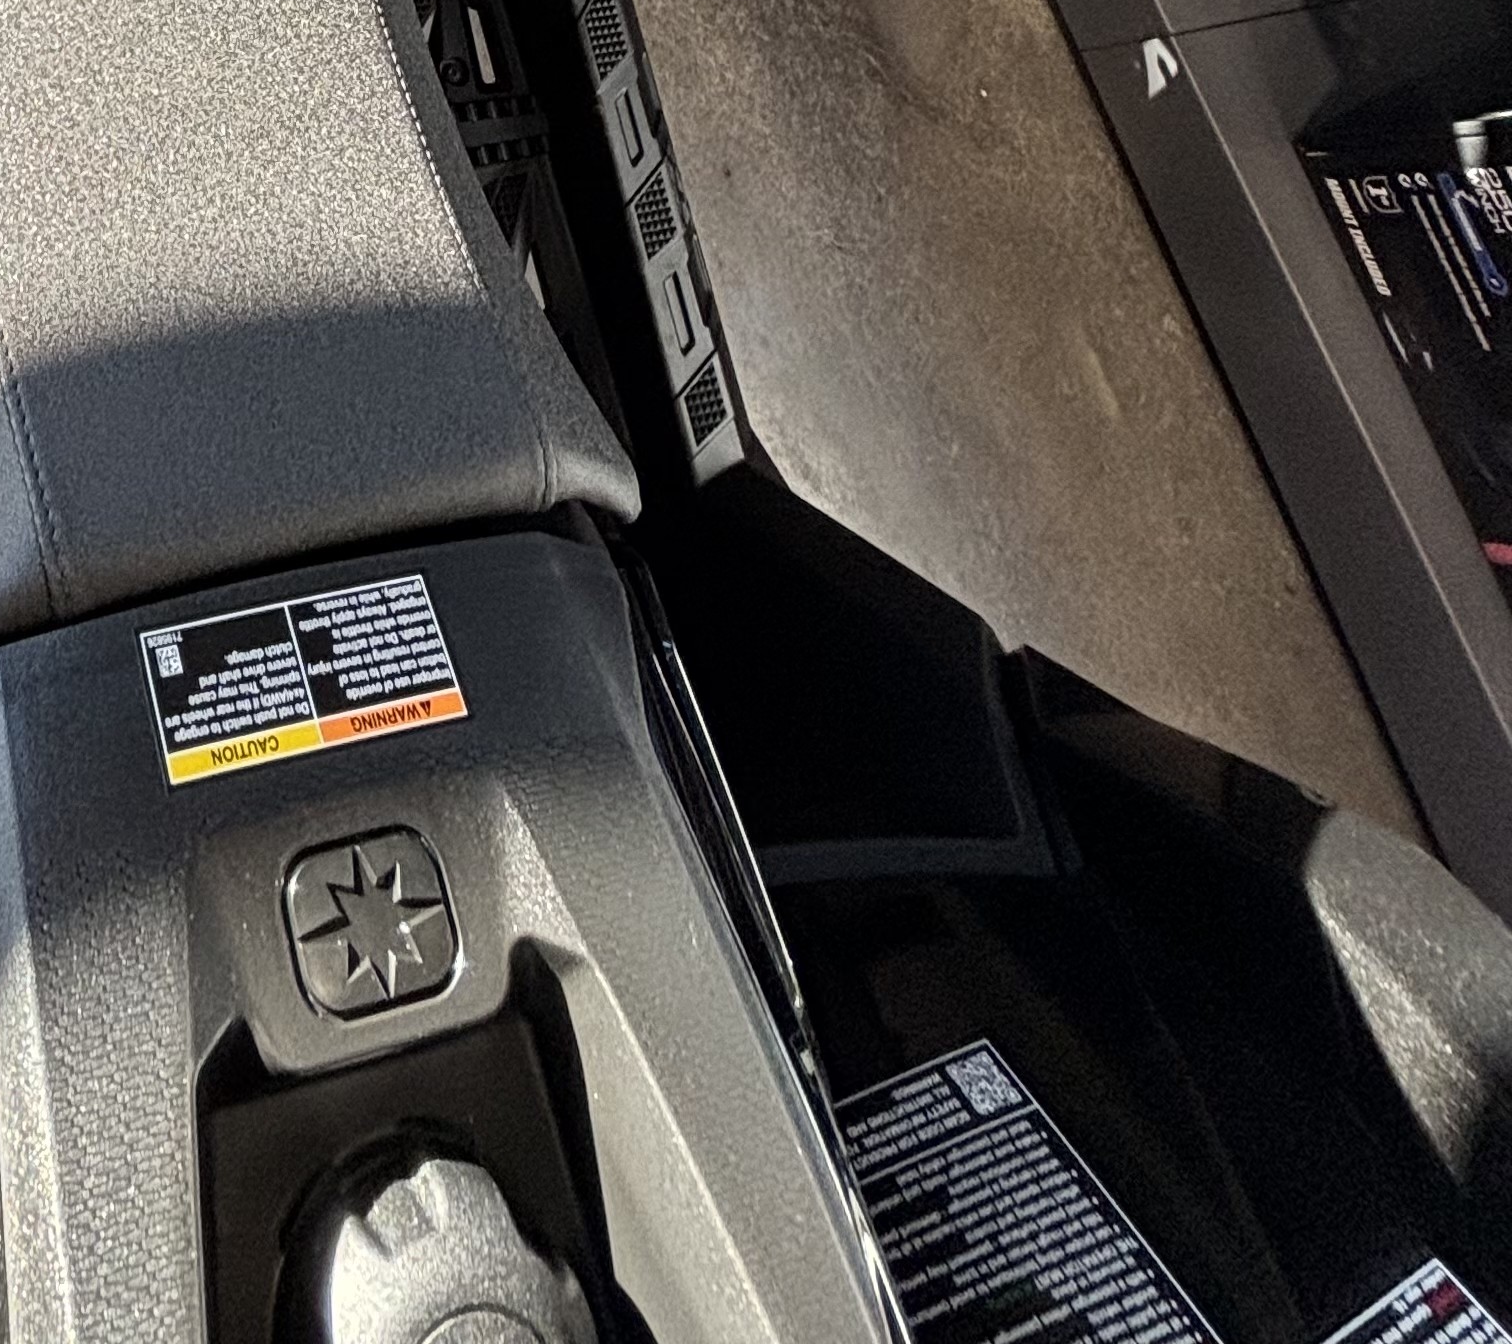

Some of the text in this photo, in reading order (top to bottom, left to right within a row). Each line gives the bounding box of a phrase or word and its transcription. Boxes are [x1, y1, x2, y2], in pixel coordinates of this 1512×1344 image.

[1324, 177, 1359, 227] MOUNT
[1348, 228, 1392, 296] INCLUDED
[356, 604, 387, 618] Always
[264, 641, 293, 657] clutch
[242, 663, 266, 677] drive
[307, 660, 333, 675] injury
[198, 673, 217, 689] and
[238, 681, 260, 694] This
[188, 690, 217, 705] cause
[217, 685, 238, 698] may
[235, 698, 252, 711] the
[277, 705, 294, 719] not
[294, 701, 310, 715] Do
[253, 706, 277, 724] push
[350, 704, 420, 732] WARNING
[210, 722, 222, 734] to
[222, 714, 253, 732] switch
[210, 735, 279, 765] CAUTION
